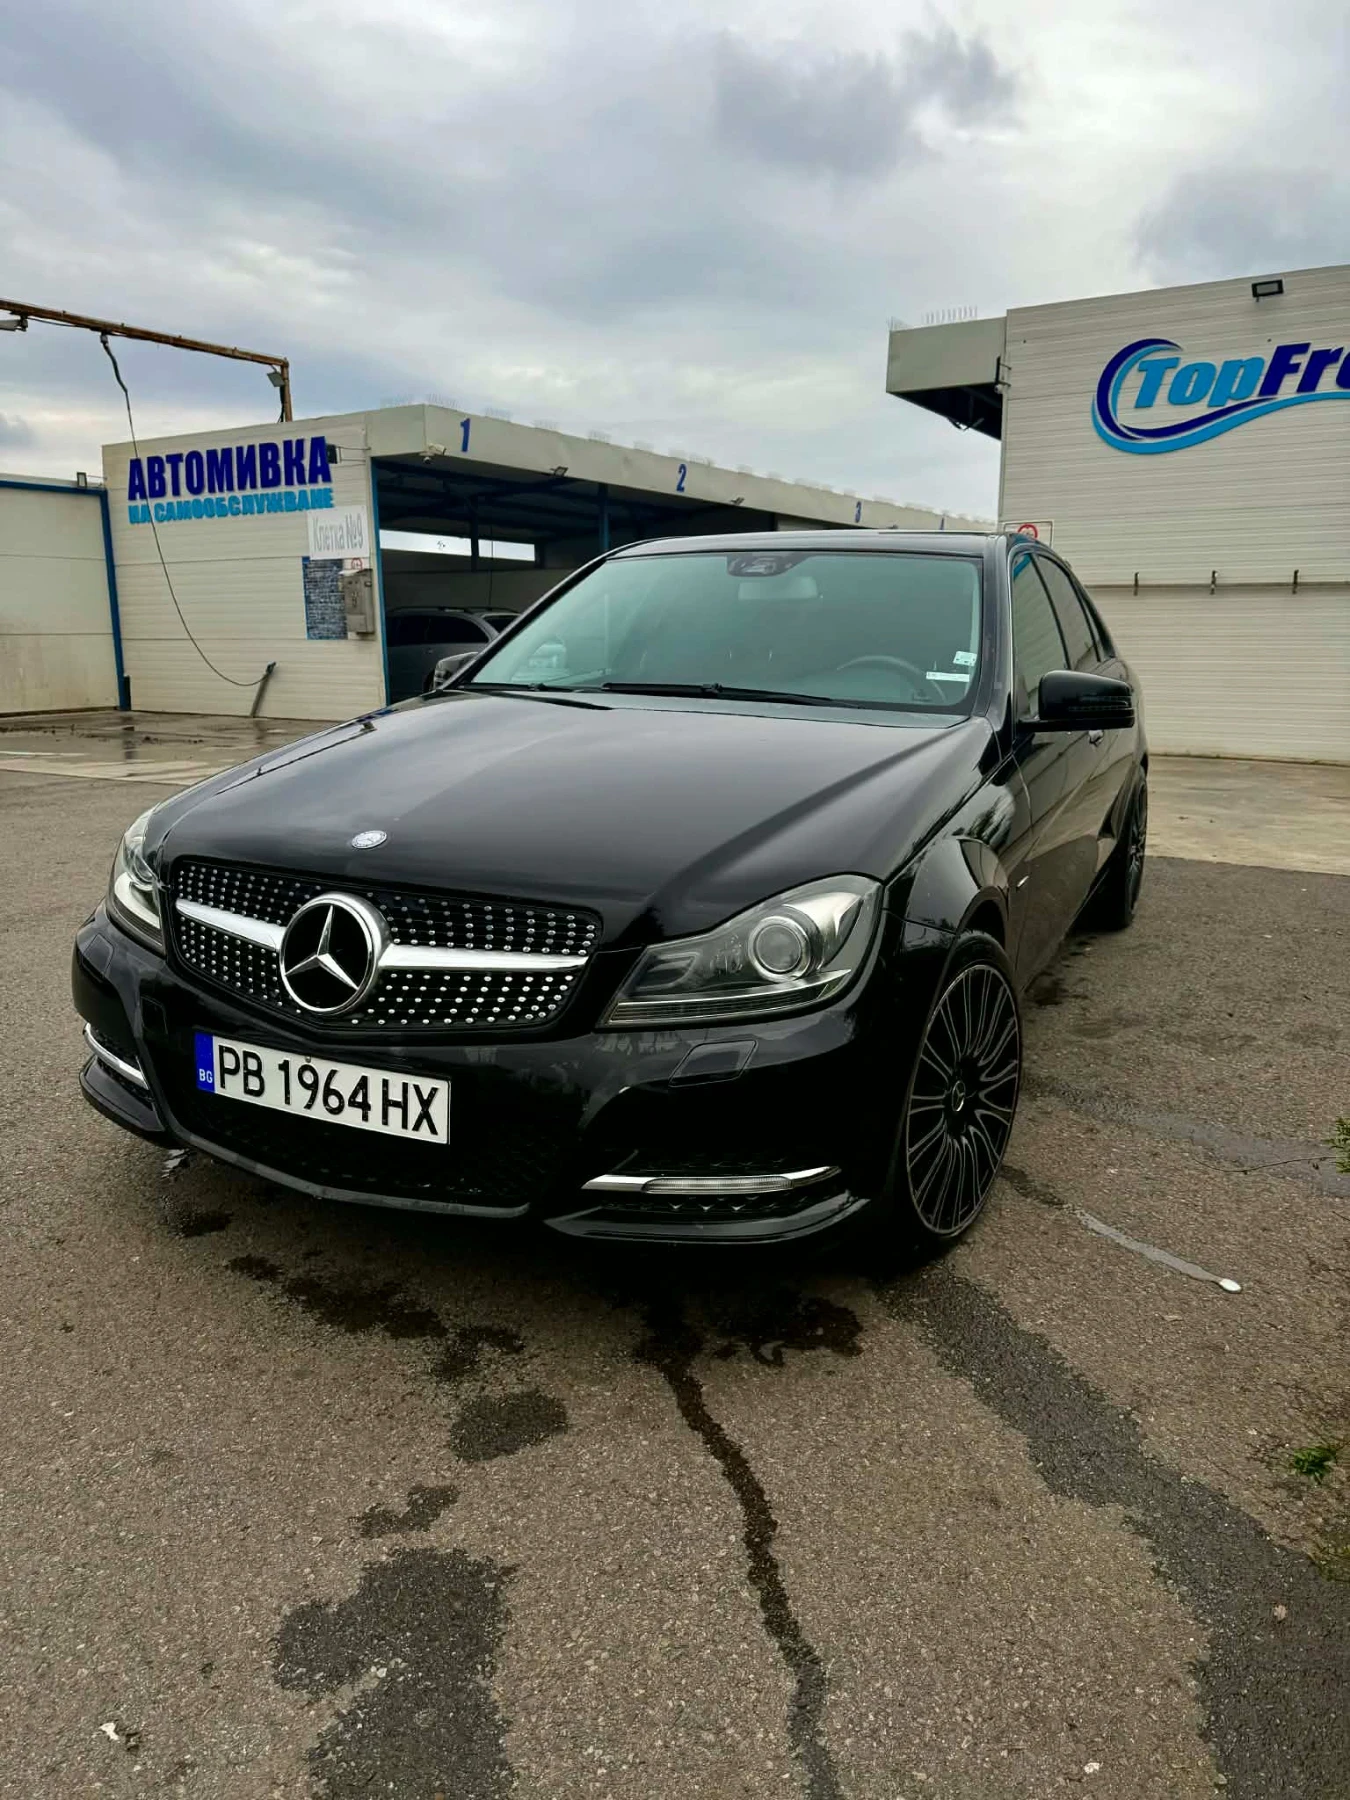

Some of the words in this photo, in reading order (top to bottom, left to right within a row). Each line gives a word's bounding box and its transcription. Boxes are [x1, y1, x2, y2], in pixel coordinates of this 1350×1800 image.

[460, 417, 471, 453] 1
[128, 436, 332, 501] АВТОМИВКА
[676, 463, 688, 493] 2
[128, 504, 151, 525] НА
[154, 487, 335, 523] САМООБСЛУЖВАНЕ
[855, 501, 862, 524] 3
[312, 515, 346, 553] Клетка
[199, 1068, 213, 1084] BG
[218, 1044, 266, 1099] PB
[278, 1059, 372, 1123] 1964
[381, 1078, 440, 1137] HX
